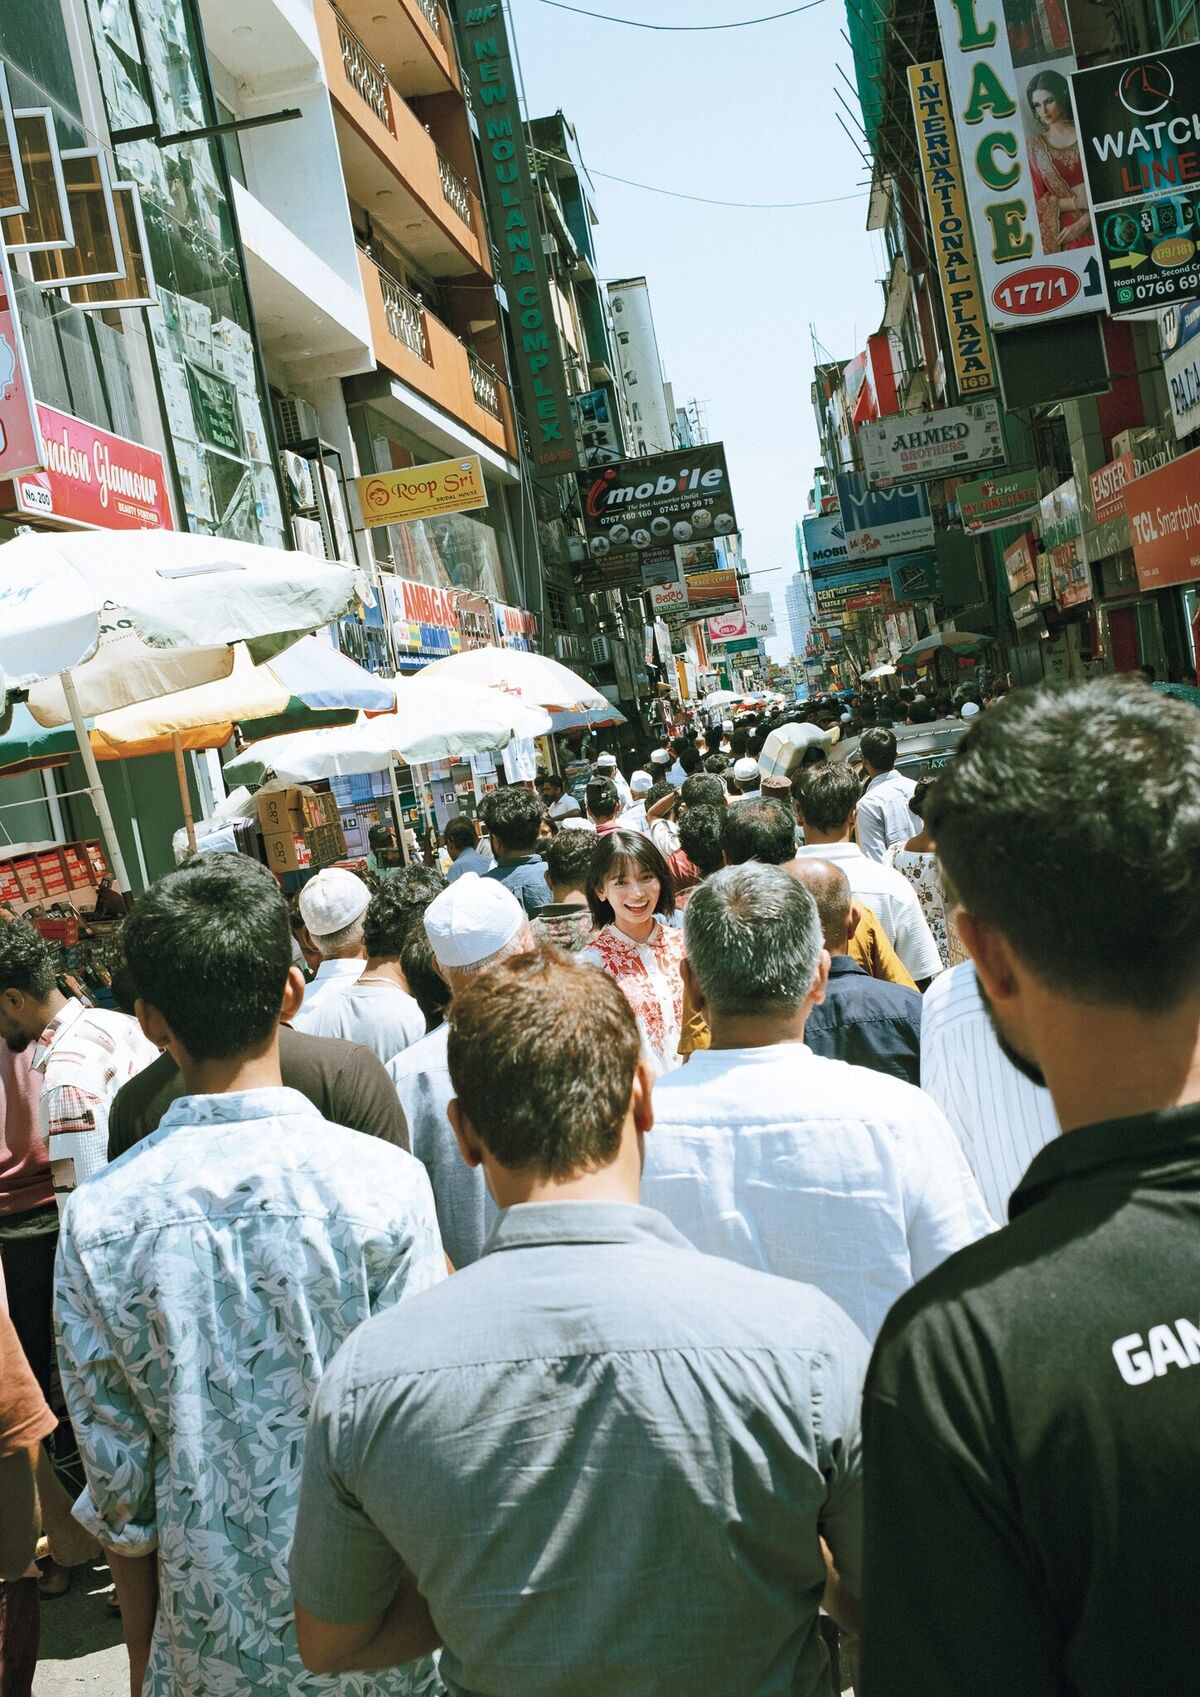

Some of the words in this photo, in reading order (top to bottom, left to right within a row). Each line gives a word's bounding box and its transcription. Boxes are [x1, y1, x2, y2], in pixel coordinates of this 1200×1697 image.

[475, 38, 507, 106] NEW
[1121, 151, 1200, 192] LINE
[486, 115, 536, 276] MOULANA
[917, 67, 970, 285] INTERNATIONAL
[950, 290, 986, 373] PLAZA
[1155, 243, 1192, 260] 179/181
[1114, 279, 1135, 288] Noon
[1137, 274, 1160, 282] Plaza,
[1161, 265, 1190, 277] Second
[1136, 280, 1175, 298] 0766
[1179, 273, 1200, 289] 69
[1000, 277, 1069, 308] 177/1
[517, 286, 563, 442] COMPLEX
[961, 377, 989, 389] 169
[892, 423, 970, 452] AHMED
[900, 441, 967, 461] BROTHERS
[93, 440, 158, 508] Glamour
[391, 480, 437, 501] Roop
[444, 471, 474, 492] Sri
[1092, 462, 1126, 503] EASTER
[24, 489, 37, 502] No.
[436, 494, 456, 503] BRIDAL
[627, 503, 638, 511] The
[639, 500, 651, 509] best
[681, 492, 699, 501] Outlet
[118, 502, 136, 516] BEAUTY
[137, 508, 158, 523] FOREVER
[600, 516, 619, 525] 0767
[622, 512, 636, 521] 160
[638, 510, 652, 518] 160
[660, 505, 679, 514] 0742
[681, 502, 690, 510] 59
[692, 500, 702, 508] 59
[703, 497, 714, 506] 75
[1133, 511, 1158, 545] TCL
[641, 549, 670, 559] Beauty
[642, 555, 672, 565] Centre
[402, 581, 459, 629] AMBIGAS
[269, 801, 279, 825] CR7
[275, 841, 287, 865] CR7
